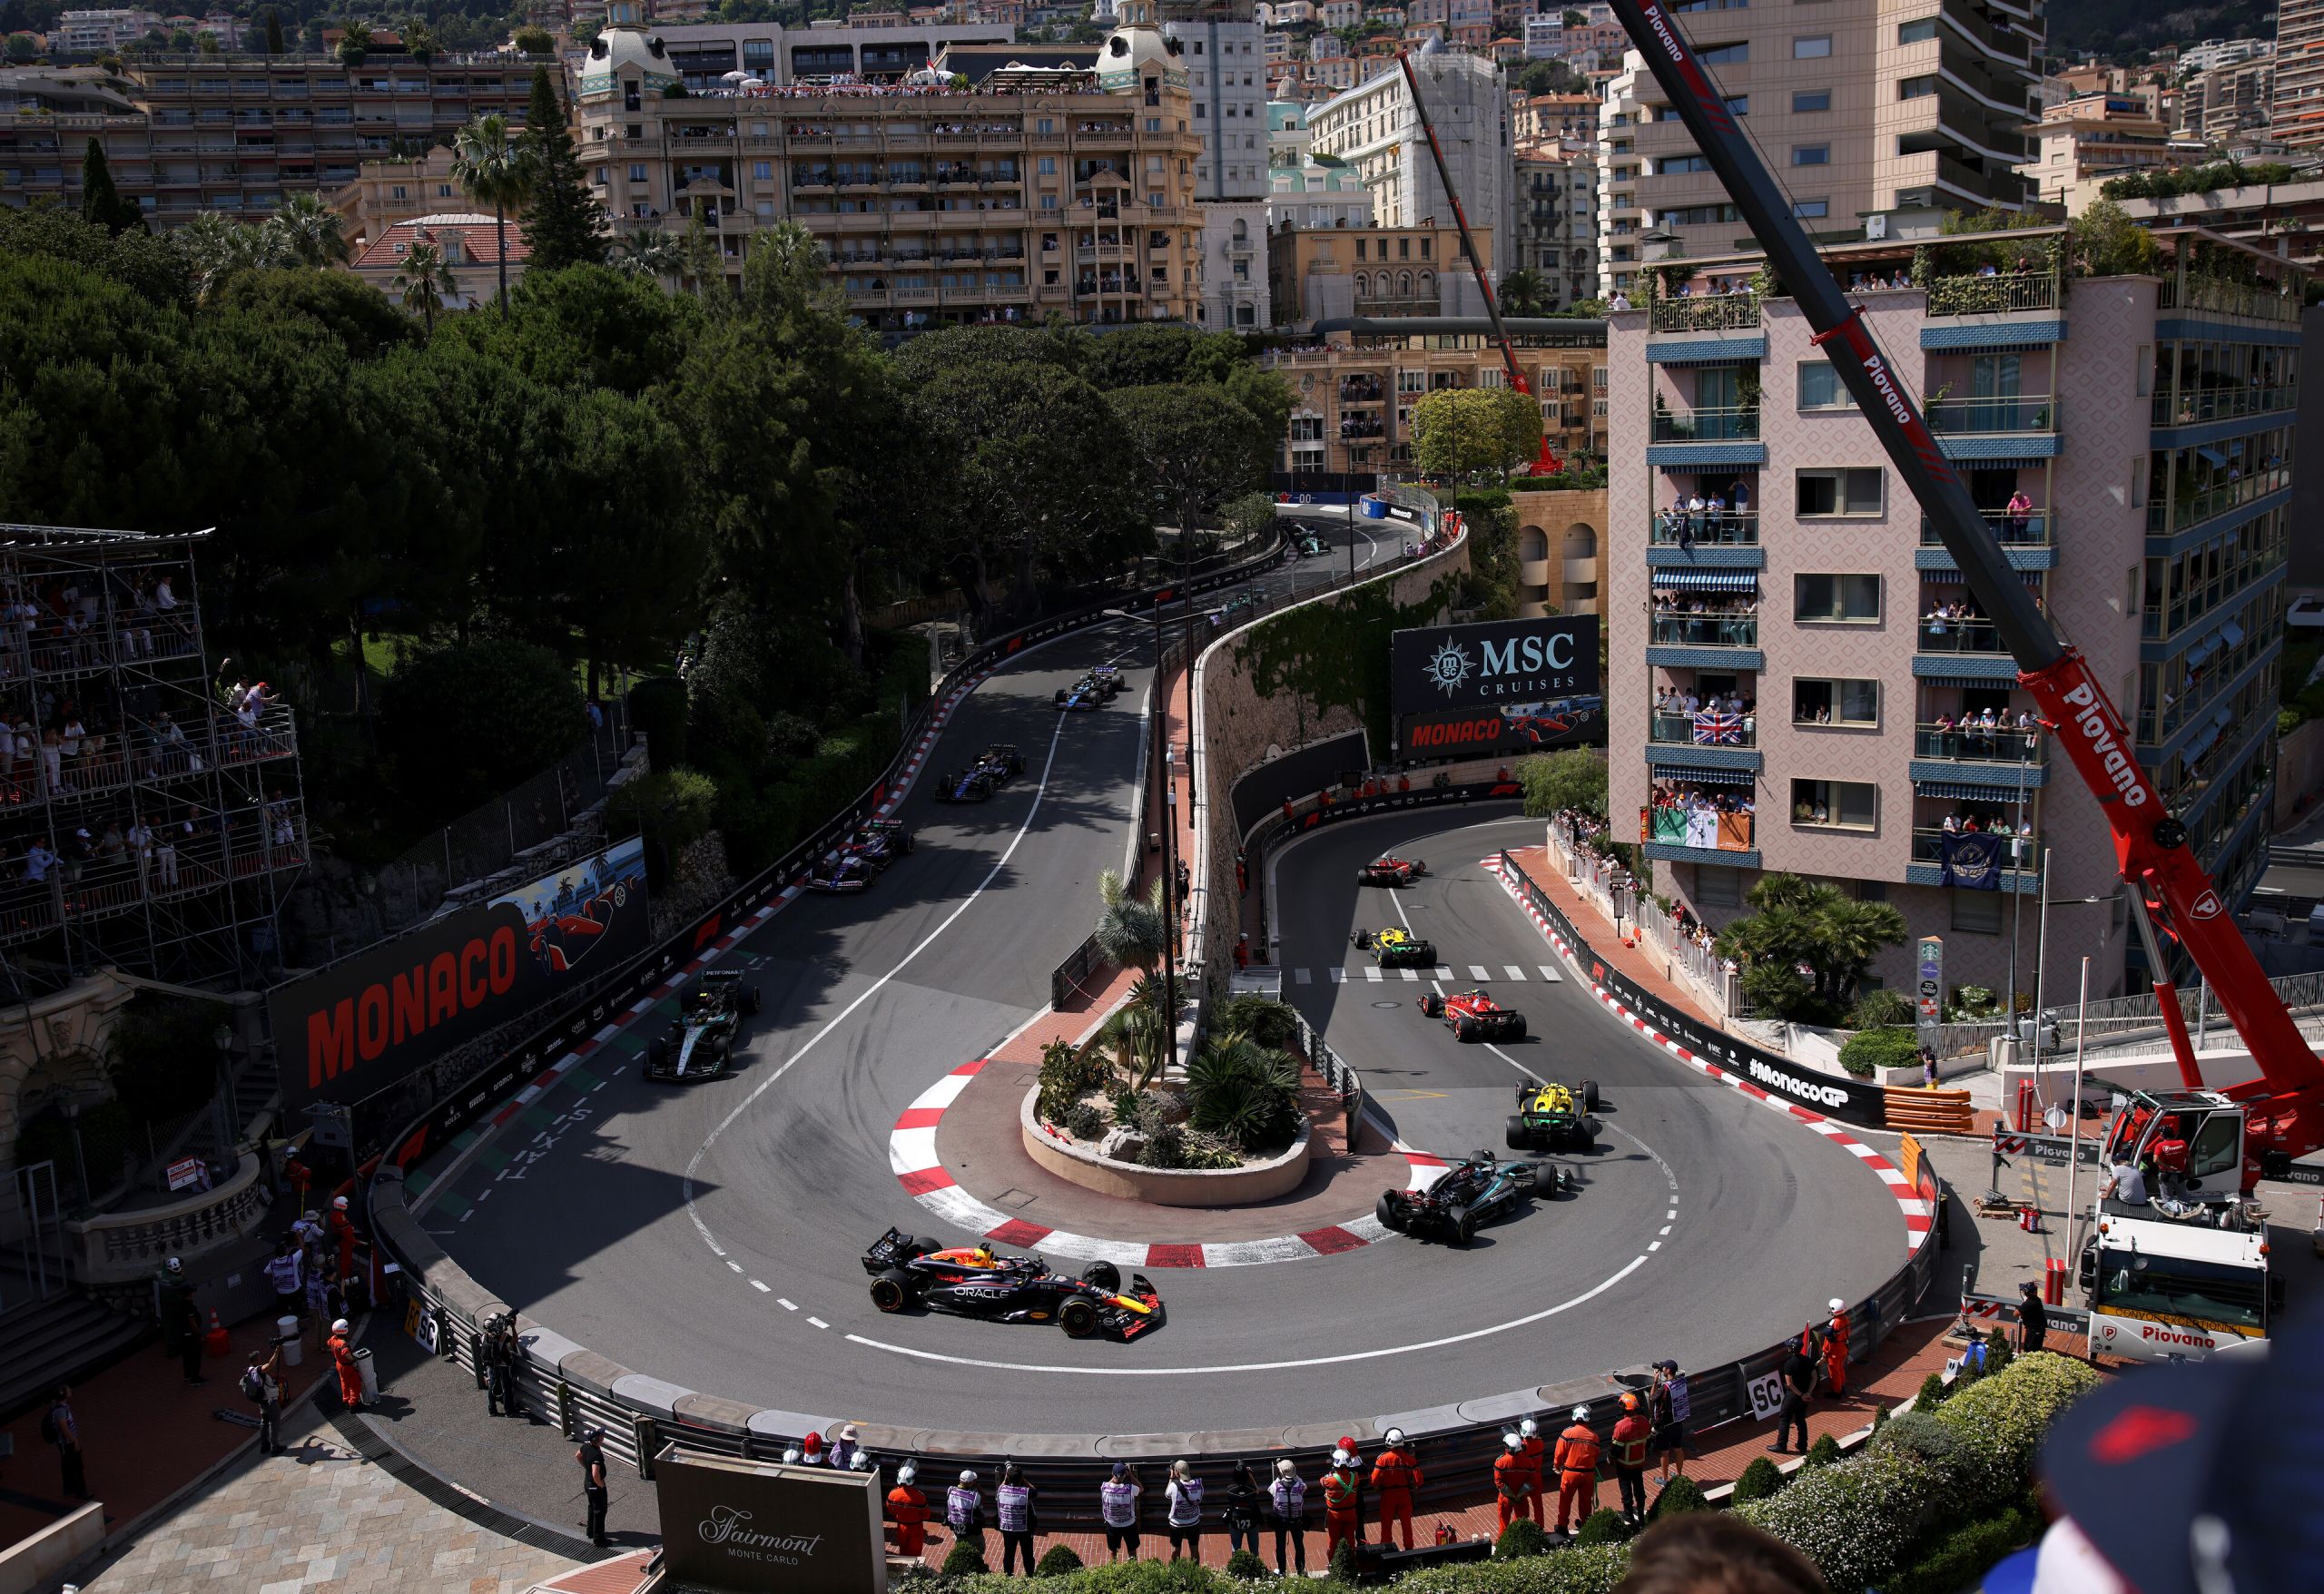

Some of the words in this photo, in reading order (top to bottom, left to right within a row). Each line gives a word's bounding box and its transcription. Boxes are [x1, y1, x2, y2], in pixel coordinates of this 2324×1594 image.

[1644, 5, 1683, 63] Piovano
[1863, 355, 1911, 424] Piovano
[1480, 633, 1574, 677] MSC
[1480, 676, 1575, 696] CRUISES
[1412, 718, 1502, 747] MONACO
[2063, 682, 2147, 807] Piovano
[308, 925, 516, 1089] MONACO
[493, 1073, 514, 1091] aramco
[1749, 1058, 1849, 1107] #MonacoGP
[444, 1111, 461, 1127] ROLEX
[506, 1108, 593, 1179] TAXIS
[2035, 1145, 2085, 1160] Piovao
[954, 1286, 1009, 1299] ORACLE
[419, 1315, 436, 1345] SC
[2142, 1325, 2215, 1349] Piovano
[1753, 1379, 1782, 1412] SC
[698, 1505, 826, 1556] Fairmont
[1236, 1519, 1250, 1530] 127
[728, 1548, 762, 1560] MONTE
[766, 1553, 799, 1566] CARLO
